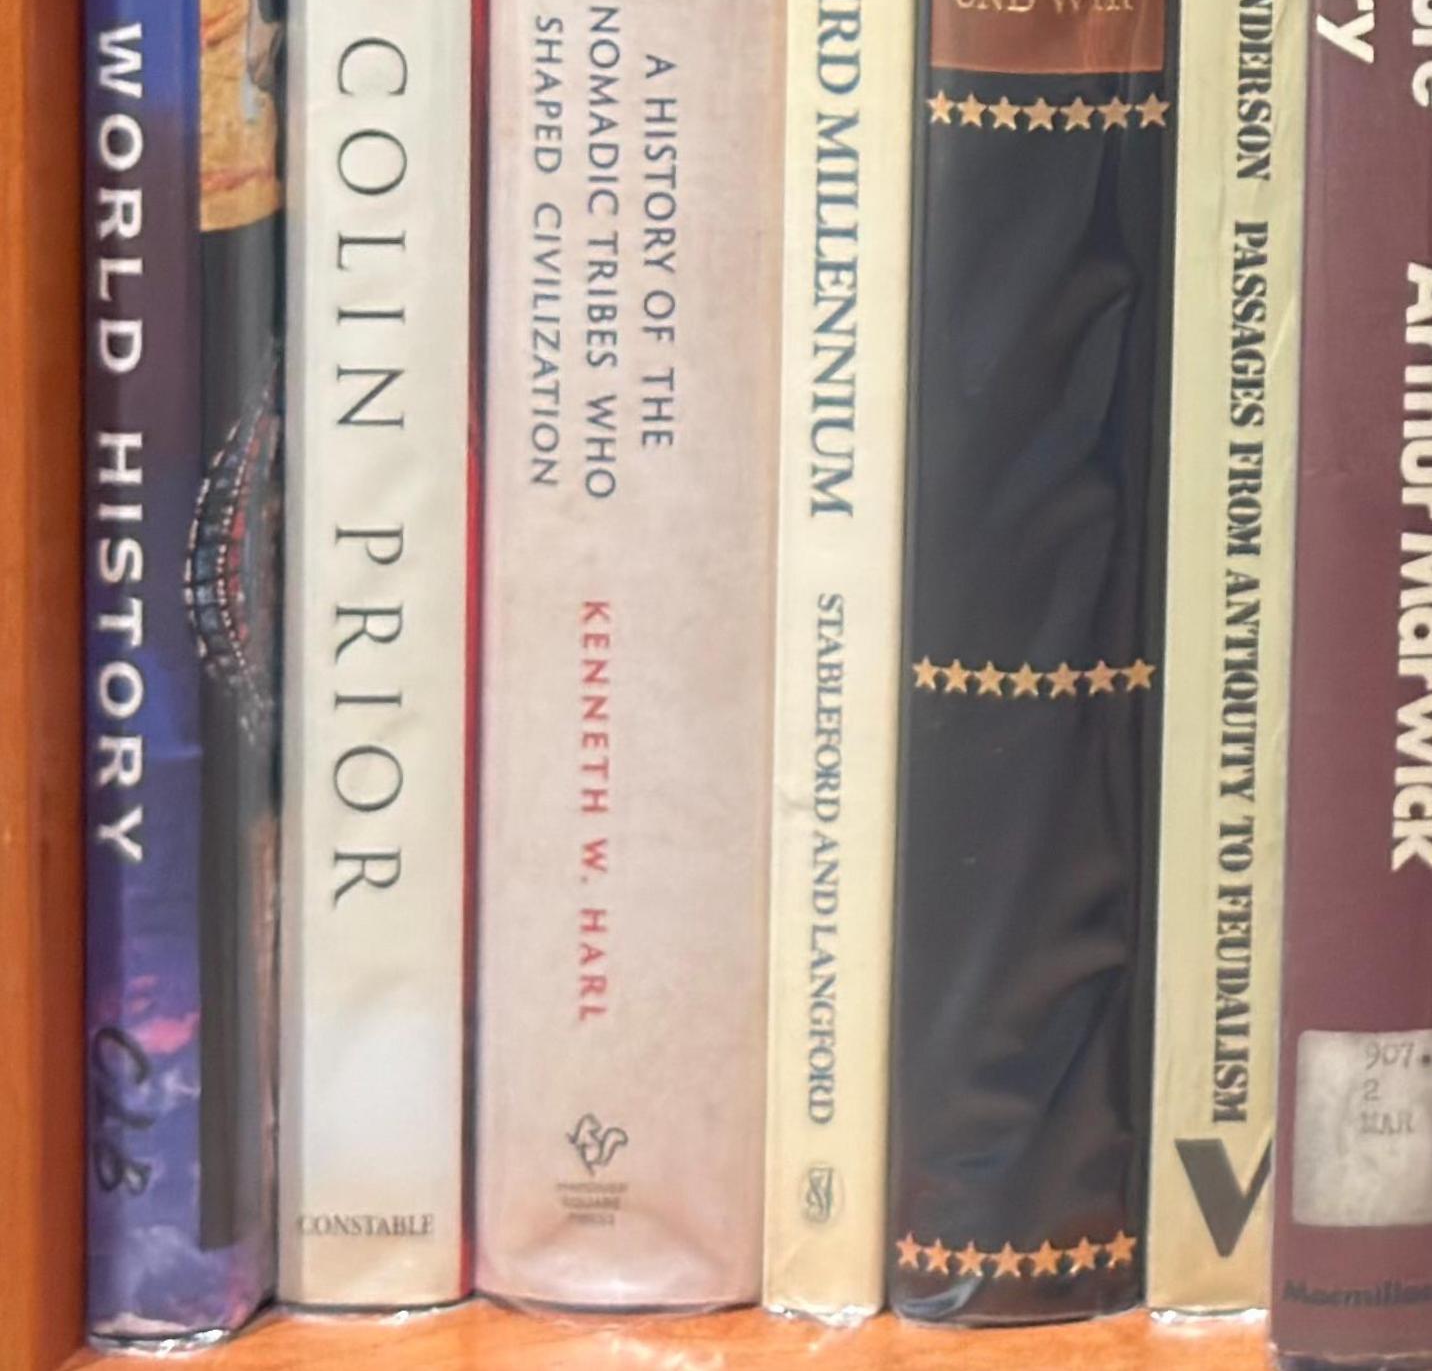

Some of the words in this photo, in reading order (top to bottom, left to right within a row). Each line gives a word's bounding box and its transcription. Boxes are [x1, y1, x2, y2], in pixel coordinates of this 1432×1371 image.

[533, 15, 564, 175] SHAPED
[587, 6, 620, 216] NOMADIC
[644, 54, 676, 79] A
[97, 22, 143, 372] WORLD
[336, 37, 408, 428] COLIN
[642, 97, 677, 274] HISTORY
[531, 203, 562, 487] CIVILIZATION
[586, 230, 618, 370] TRIBES
[642, 290, 676, 343] OF
[809, 112, 862, 517] MILLENNIUM
[1230, 220, 1269, 427] PASSAGES
[585, 394, 618, 500] WHO
[641, 367, 675, 447] THE
[1225, 442, 1265, 557] FROM
[97, 433, 143, 861] HISTORY
[334, 526, 405, 908] PRIOR
[578, 600, 611, 815] KENNETH
[813, 593, 845, 823] STABLEFORD
[1219, 570, 1261, 803] ANTIQUITY
[579, 837, 610, 883] W.
[810, 834, 842, 915] AND
[1216, 816, 1255, 873] TO
[578, 907, 610, 1022] HARL
[807, 923, 840, 1125] LANGFORD
[1211, 884, 1254, 1124] FEUDALISM
[297, 1213, 434, 1238] CONSTABLE
